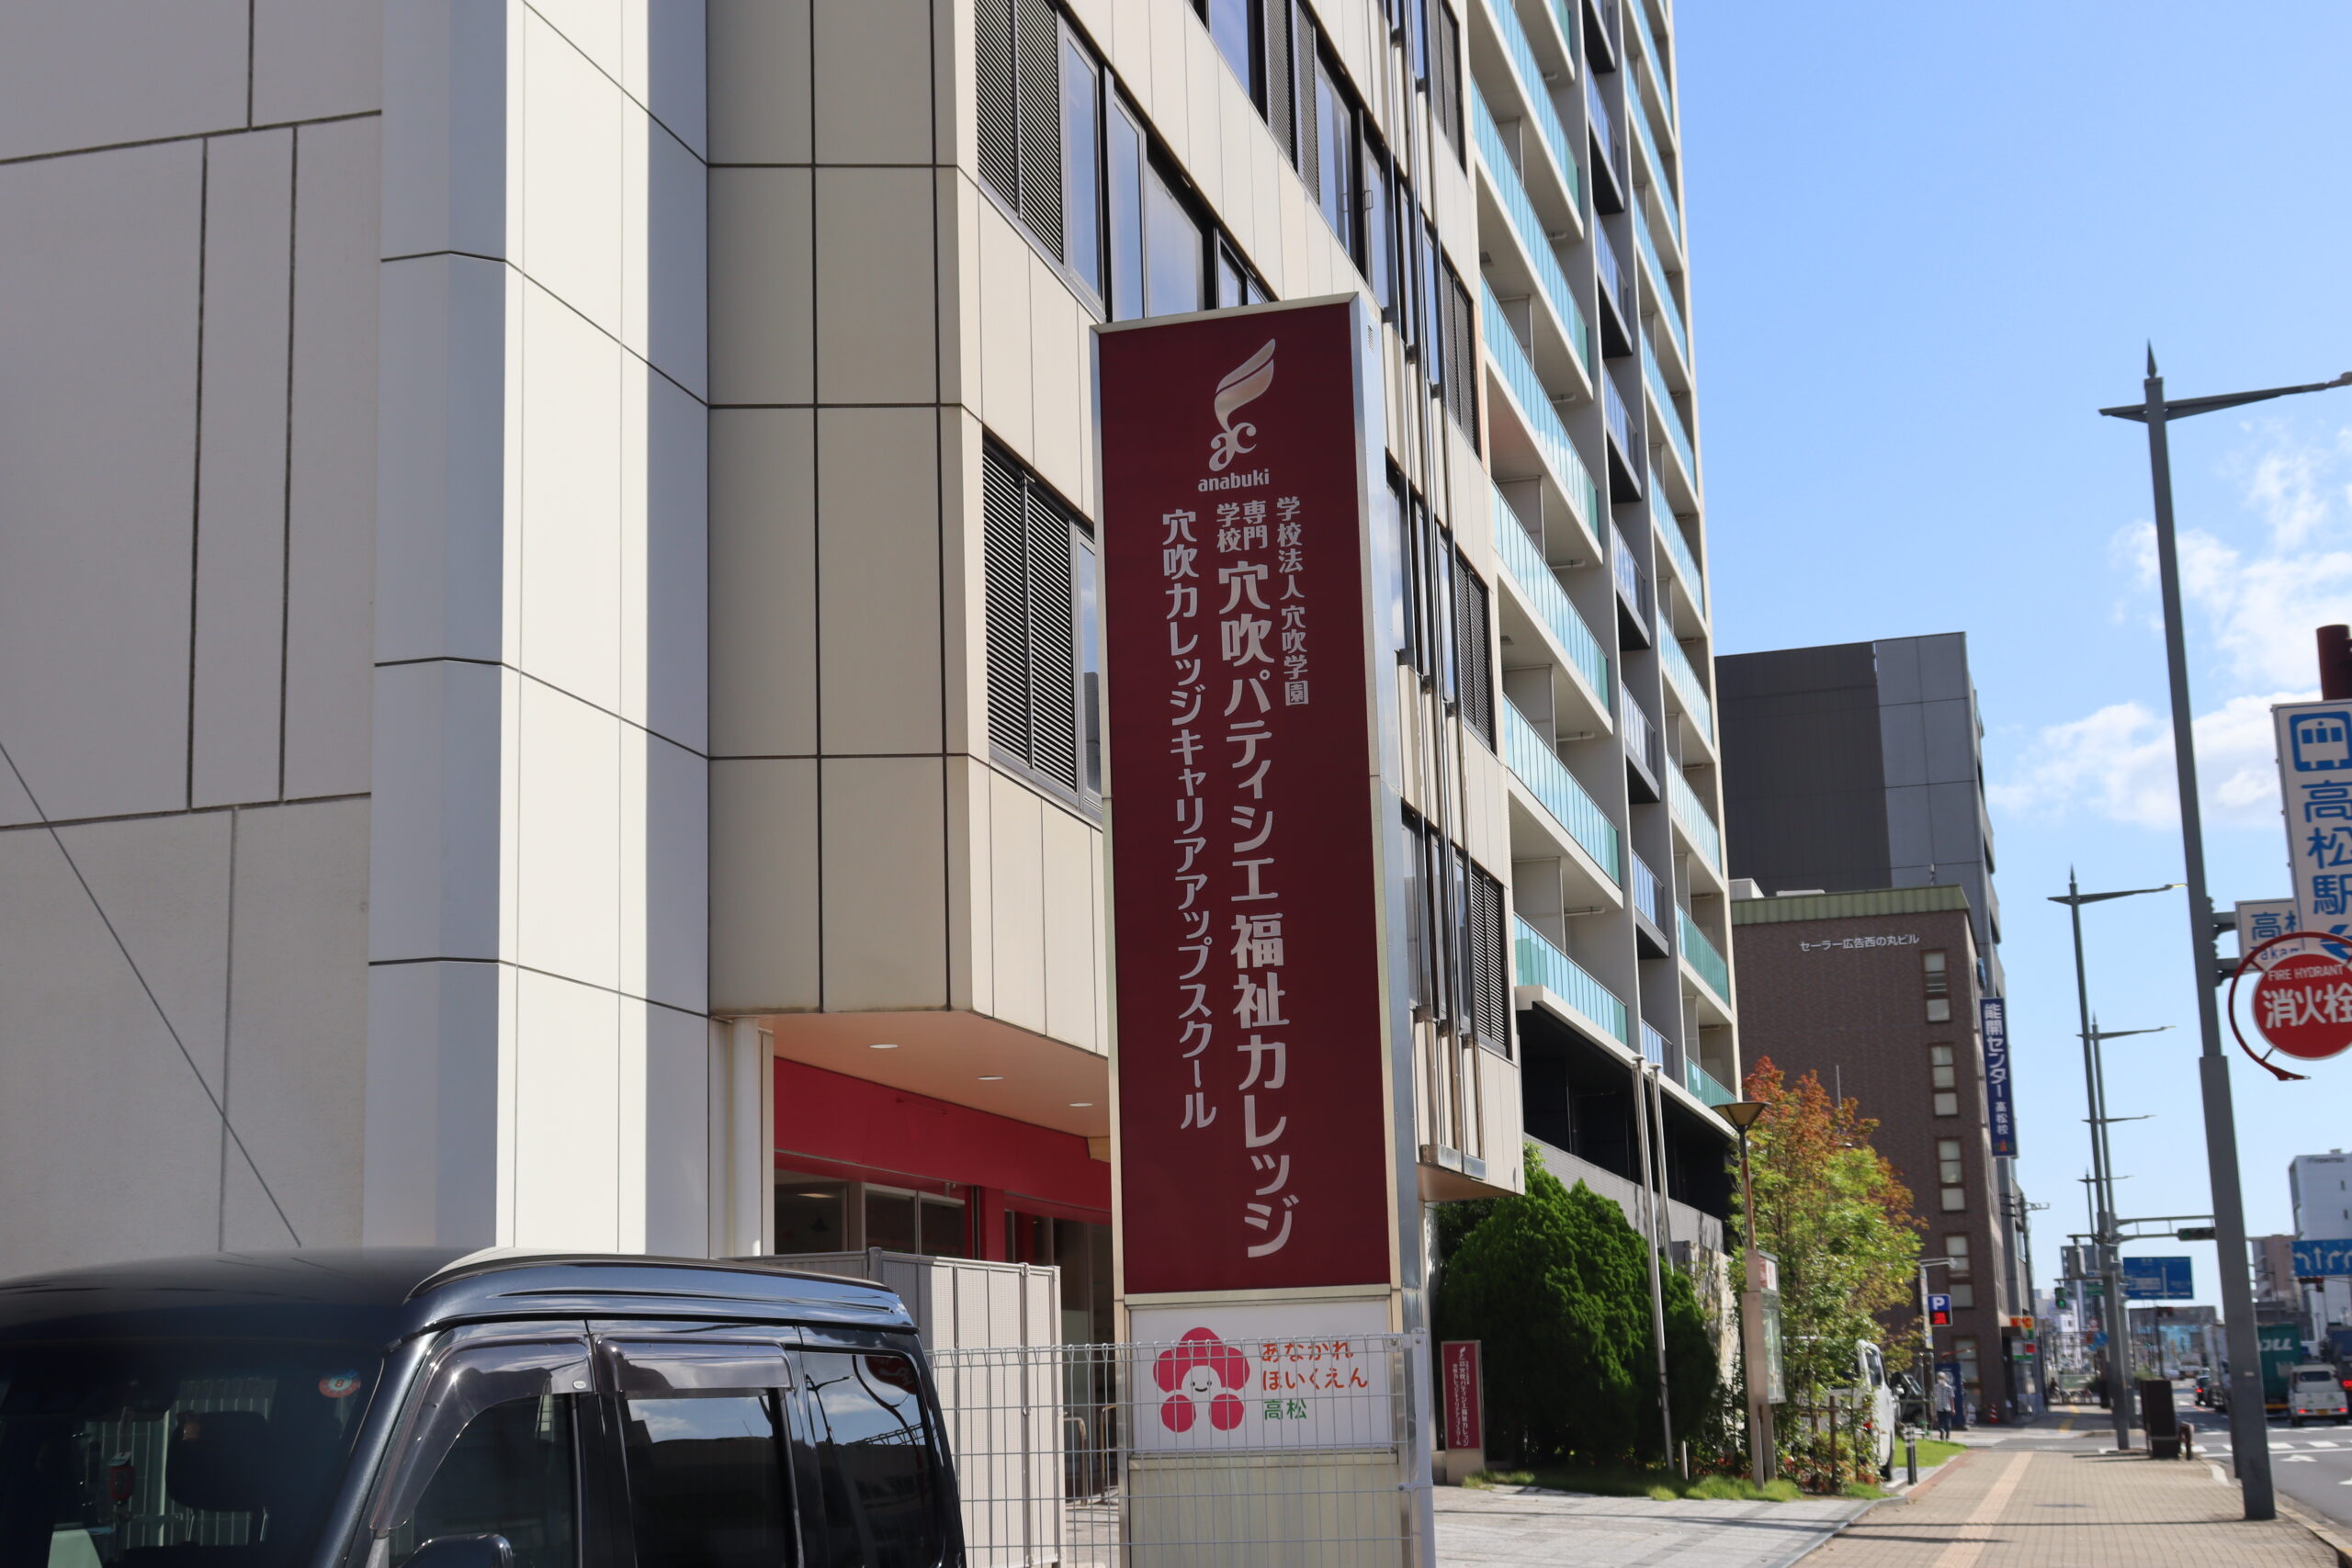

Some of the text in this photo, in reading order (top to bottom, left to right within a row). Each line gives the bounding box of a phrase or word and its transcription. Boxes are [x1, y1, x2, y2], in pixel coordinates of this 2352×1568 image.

[1198, 468, 1270, 492] anabuki
[1162, 509, 1217, 1130] 穴吹カレッジキャリアアップスクール
[2301, 779, 2352, 916] 高松駅
[1218, 560, 1300, 1258] 穴吹パティシエ福祉カレッジ
[1800, 933, 1920, 952] セーラー広告西の丸ビル
[2268, 964, 2344, 982] FIRE HYDRANT
[2262, 983, 2352, 1029] 消火栓
[1984, 1003, 2009, 1135] 能開センター 高松校
[1932, 1297, 1945, 1311] P
[1262, 1368, 1368, 1392] ほいくえん
[1263, 1397, 1306, 1421] 高松
